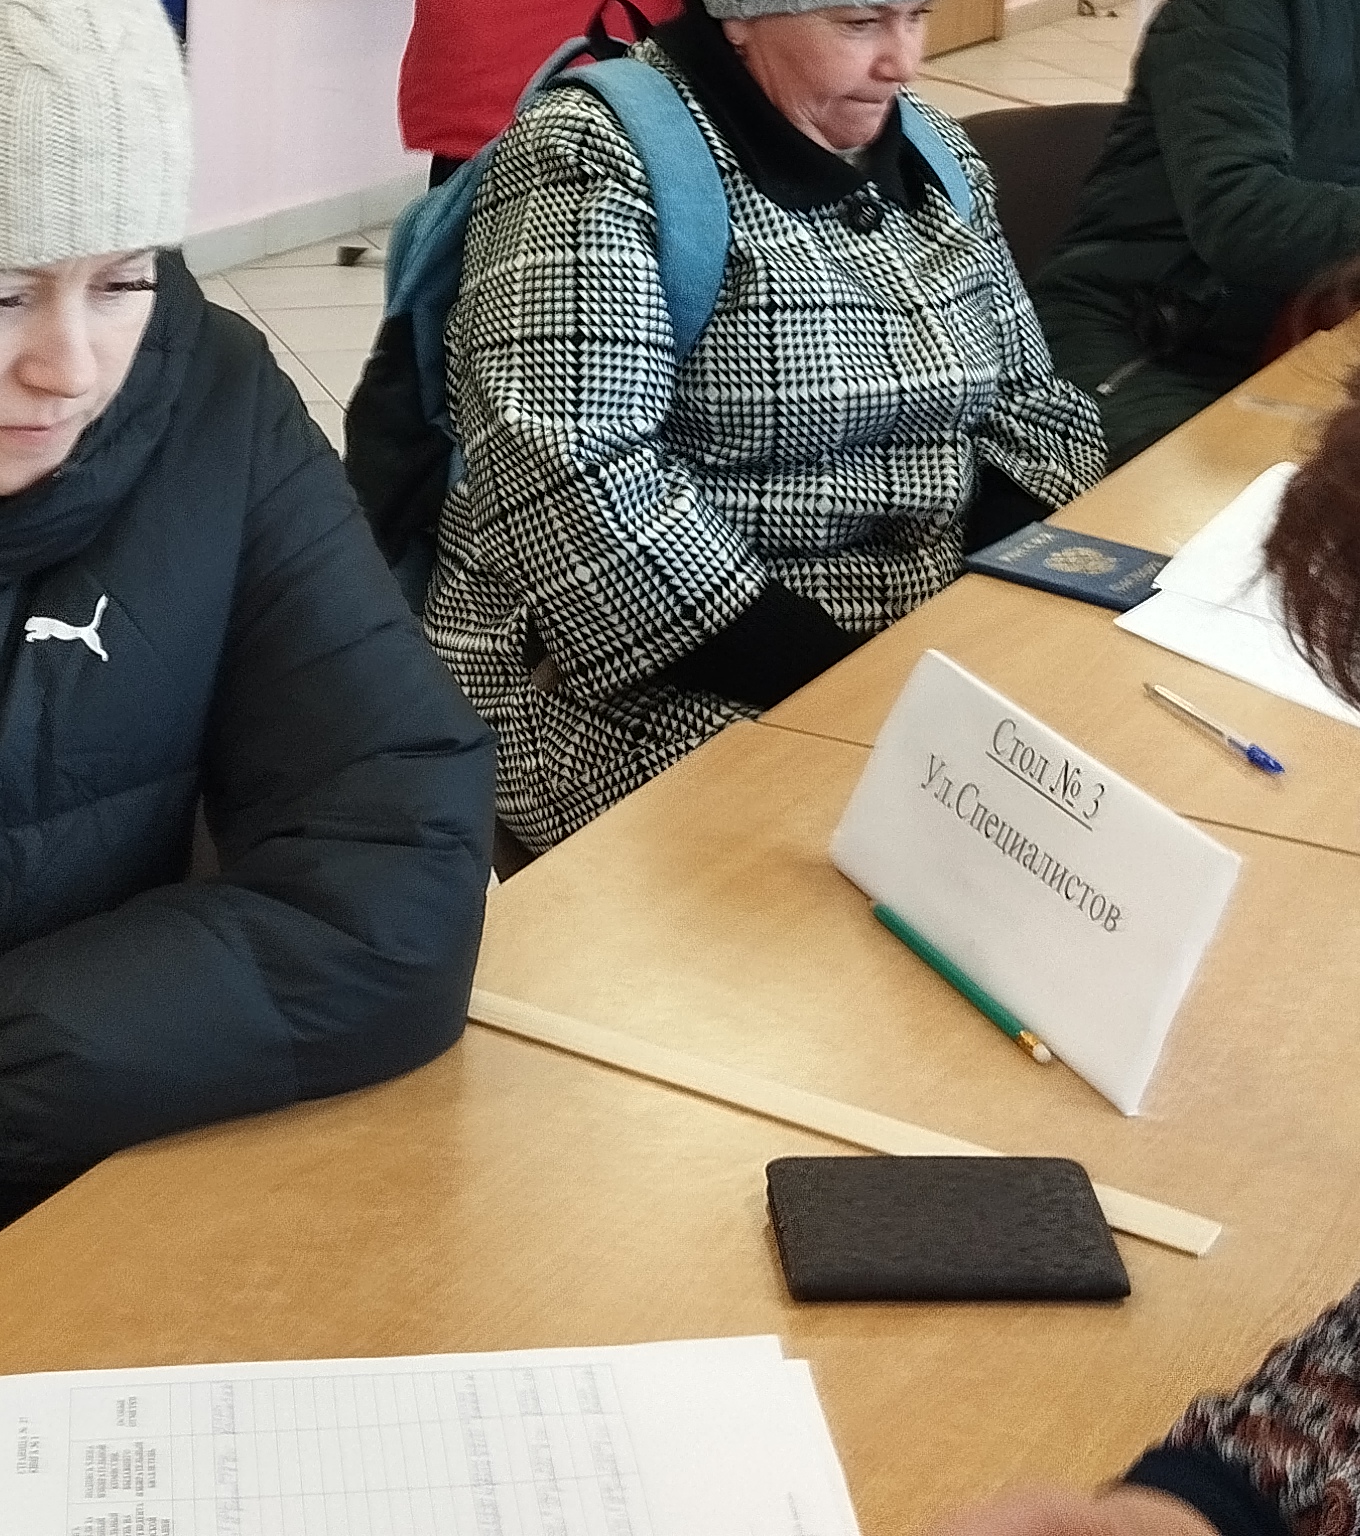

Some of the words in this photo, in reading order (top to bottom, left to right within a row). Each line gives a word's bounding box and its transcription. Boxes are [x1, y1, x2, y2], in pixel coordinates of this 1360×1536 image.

[992, 718, 1049, 785] Стол
[1050, 759, 1082, 808] №
[1082, 782, 1106, 819] 3
[920, 754, 1123, 933] Ул.Специалистов
